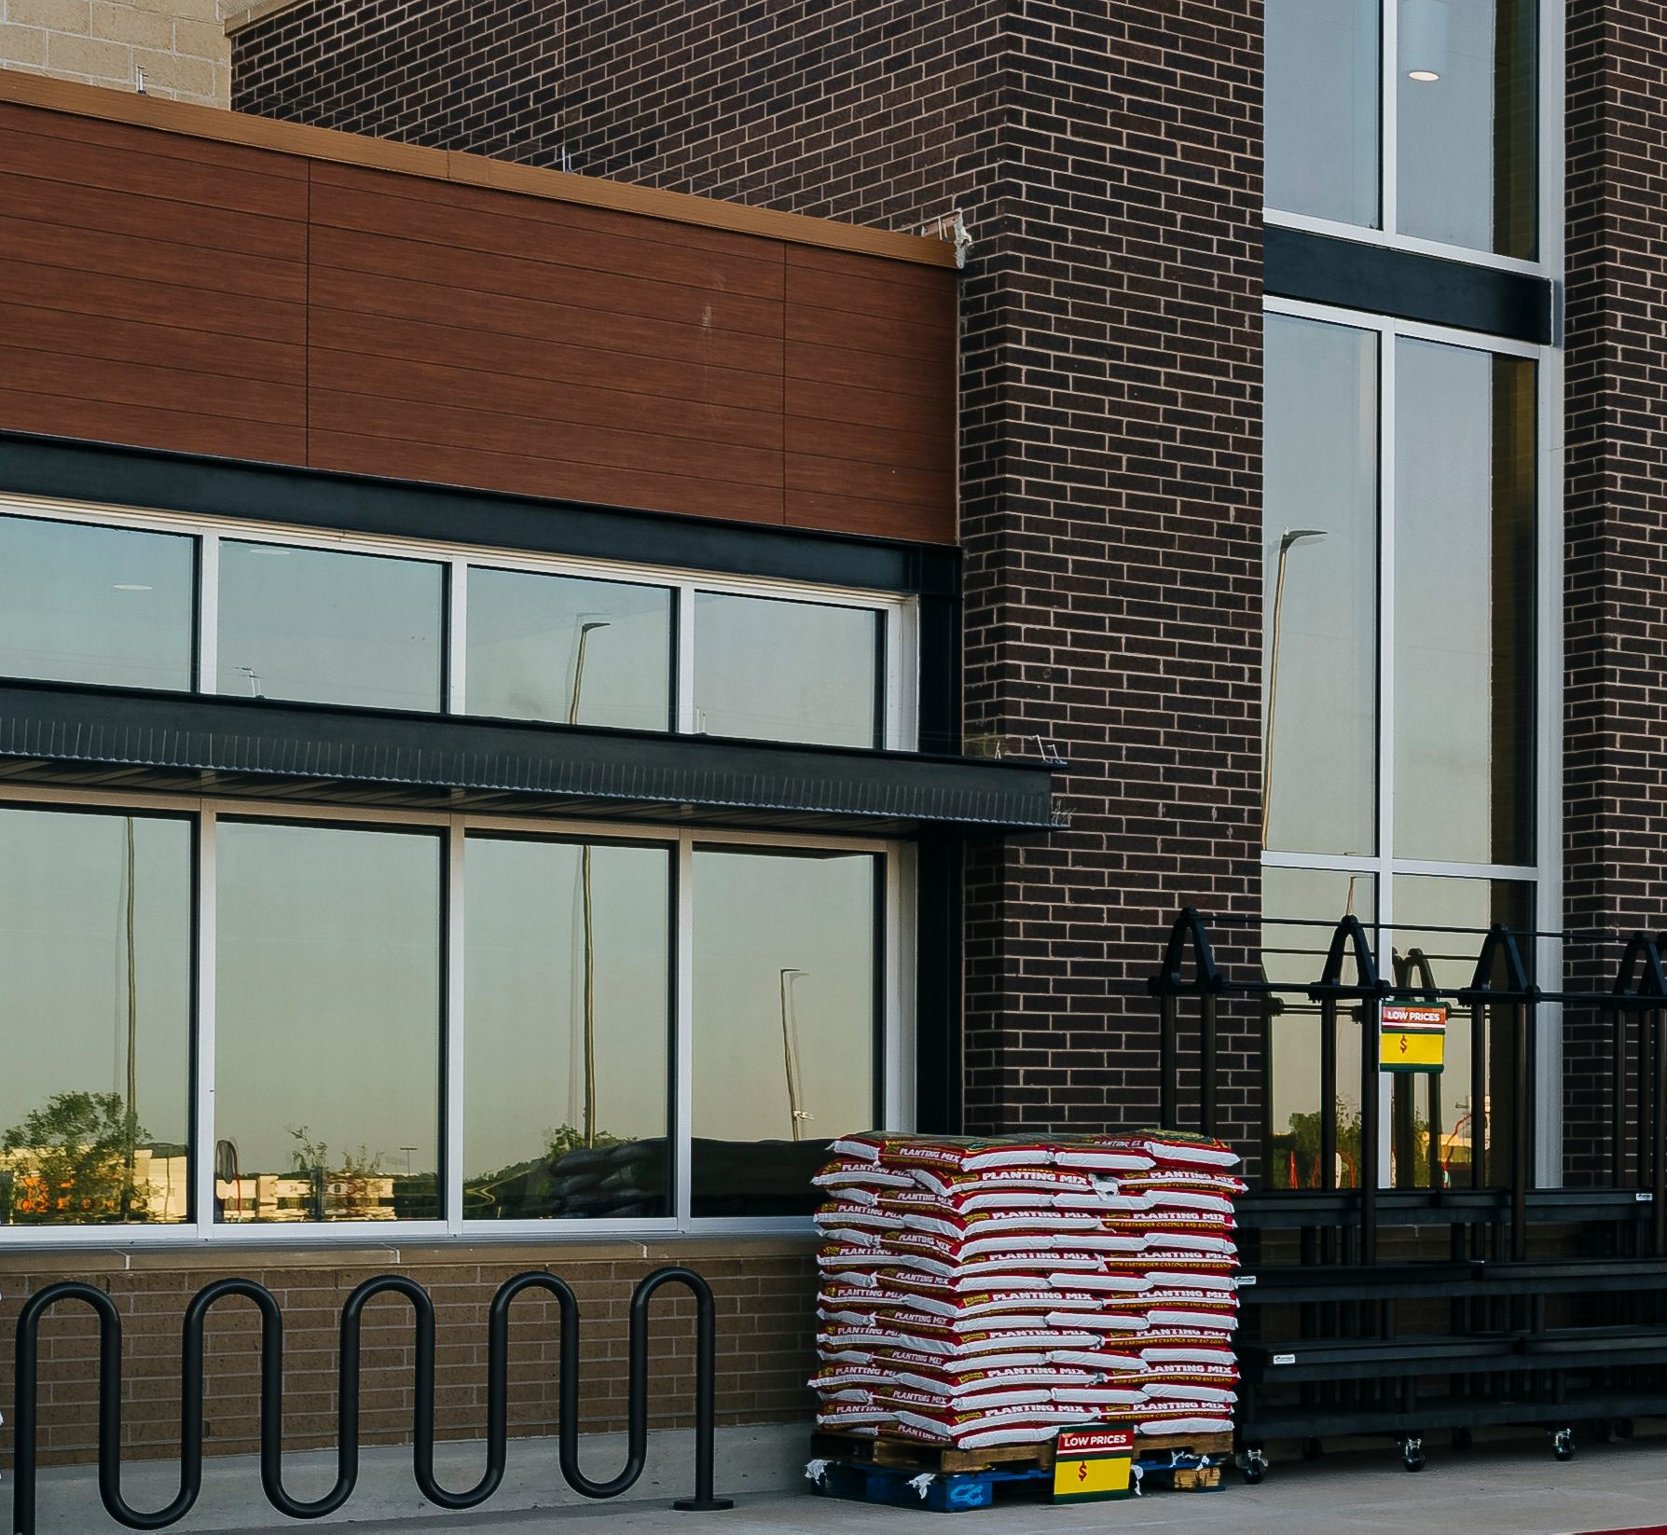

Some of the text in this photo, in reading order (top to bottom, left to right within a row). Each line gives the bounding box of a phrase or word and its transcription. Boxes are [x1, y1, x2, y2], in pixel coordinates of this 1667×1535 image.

[1387, 1011, 1440, 1021] LOW PRICES
[982, 1171, 1087, 1185] PLANTING MIX
[1150, 1171, 1211, 1180] PLANTING
[1133, 1212, 1225, 1223] PLANTING MIX
[989, 1252, 1061, 1261] PLANTING
[992, 1292, 1063, 1301] PLANTING
[1138, 1290, 1204, 1298] PLANTING
[987, 1367, 1057, 1378] PLANTING
[1140, 1364, 1232, 1374] PLANTING MIX
[985, 1404, 1055, 1417] PLANTING
[1133, 1402, 1199, 1411] PLANTING
[1064, 1435, 1127, 1447] LOW PRICES
